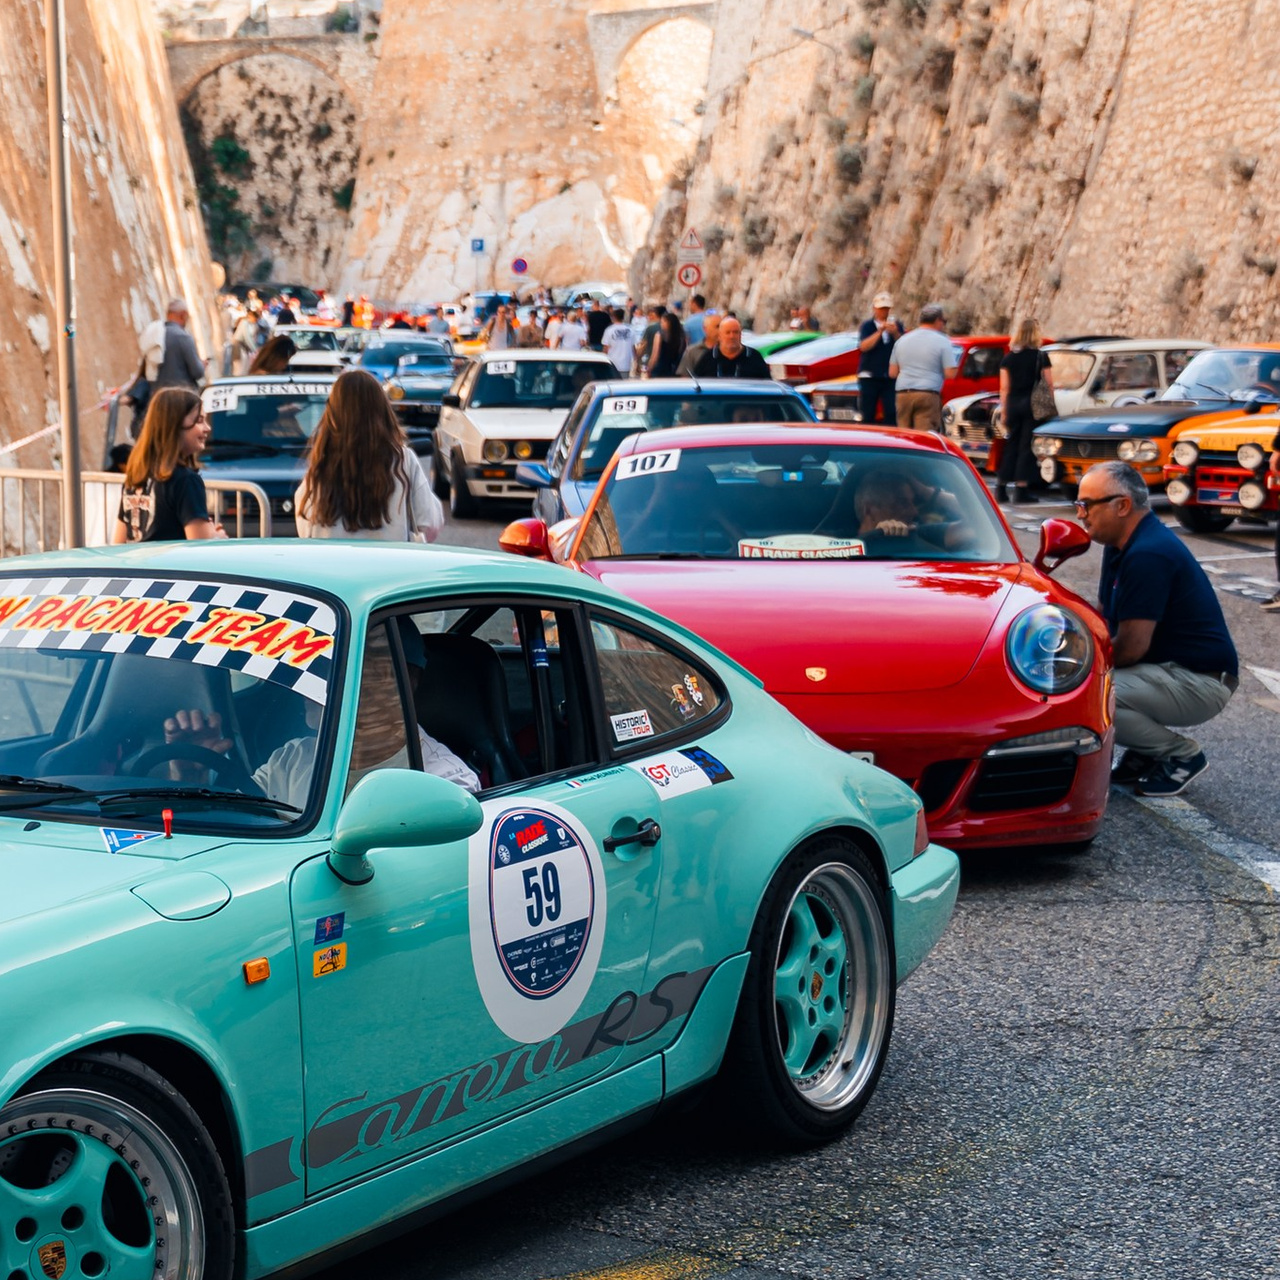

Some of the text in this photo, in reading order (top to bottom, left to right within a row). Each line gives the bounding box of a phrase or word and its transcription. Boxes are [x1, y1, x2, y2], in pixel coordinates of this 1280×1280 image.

[211, 397, 228, 409] 51
[614, 400, 637, 411] 69
[628, 453, 672, 473] 107
[743, 547, 761, 558] LA
[763, 548, 799, 559] RADE
[13, 595, 193, 638] RACING
[187, 607, 335, 665] TEAM
[632, 724, 651, 736] TOUR
[647, 763, 671, 780] GT
[515, 819, 548, 848] RADE
[522, 861, 562, 928] 59
[581, 971, 688, 1059] RS
